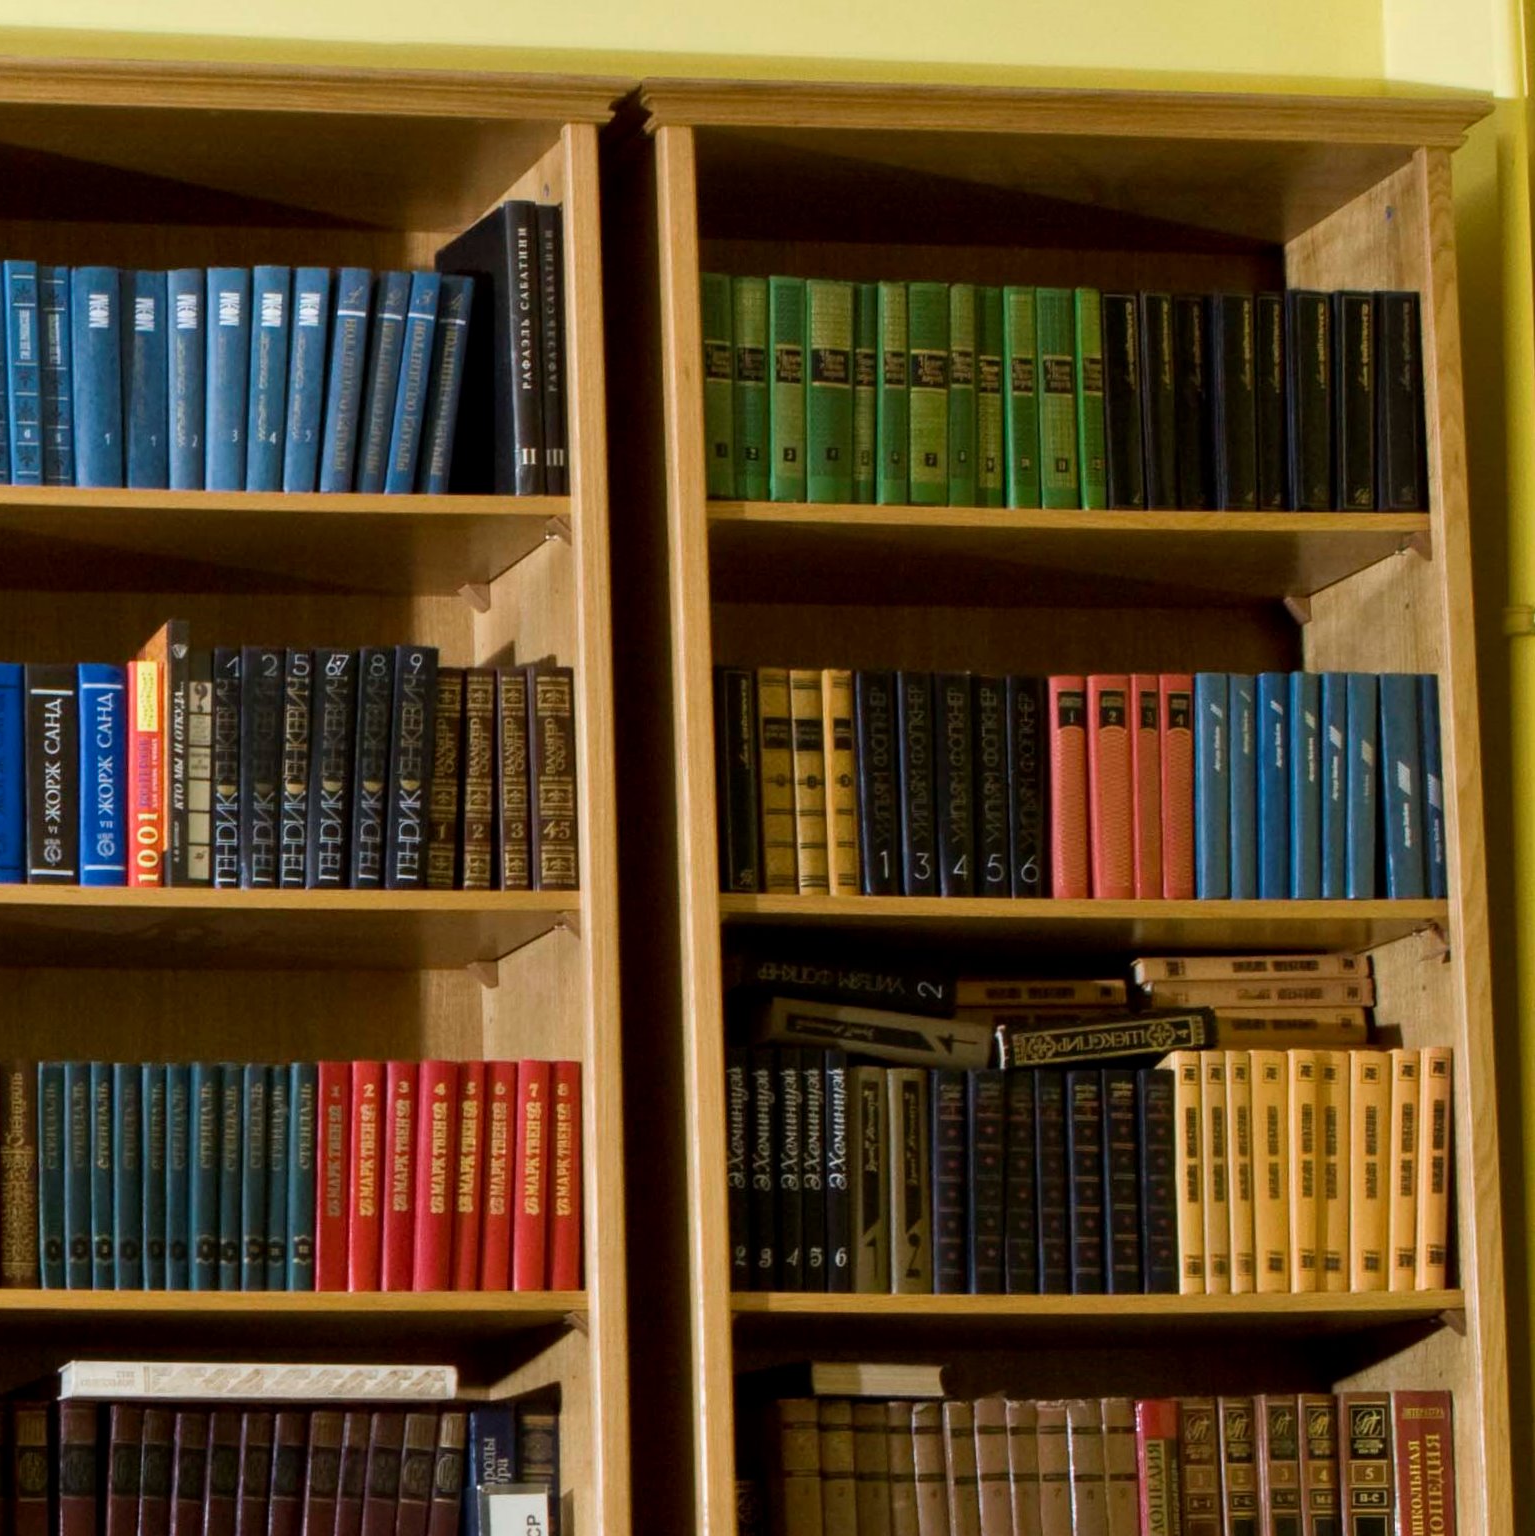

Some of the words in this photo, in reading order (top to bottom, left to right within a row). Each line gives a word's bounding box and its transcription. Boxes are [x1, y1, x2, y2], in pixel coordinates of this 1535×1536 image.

[518, 227, 529, 319] САБАТИНИ
[521, 325, 533, 391] РАФАЭЛЬ
[522, 449, 537, 465] II
[410, 653, 423, 674] 9
[44, 698, 63, 755] САНД
[45, 762, 61, 823] ЖОРЖ
[137, 812, 158, 884] 1001
[363, 1084, 375, 1097] 2
[360, 1122, 376, 1156] ТВЕН
[360, 1159, 375, 1197] МАРК
[1365, 1467, 1374, 1480] 5
[1408, 1440, 1425, 1536] ШКОЛЬНАЯ
